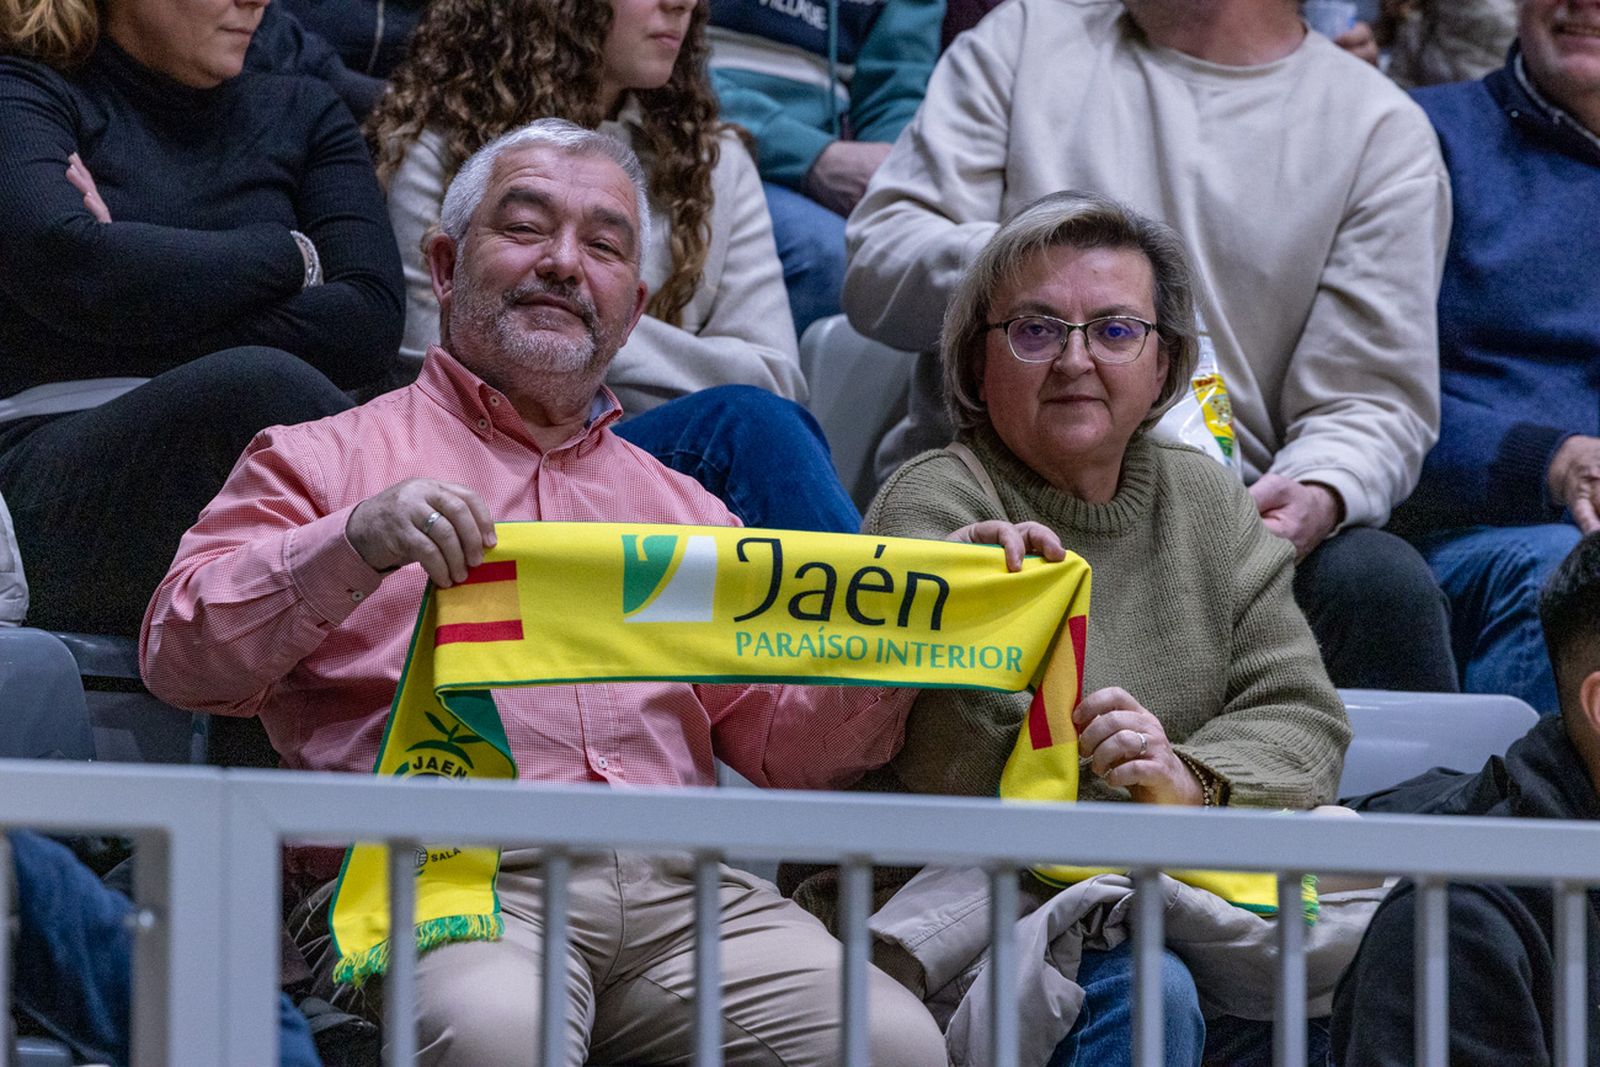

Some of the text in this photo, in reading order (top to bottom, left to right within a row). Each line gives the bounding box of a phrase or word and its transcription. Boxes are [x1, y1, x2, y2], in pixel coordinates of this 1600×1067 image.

[733, 537, 950, 630] Jaén
[735, 626, 1023, 673] PARAÍSO INTERIOR
[412, 756, 468, 778] JAEN
[431, 847, 462, 862] SALA
